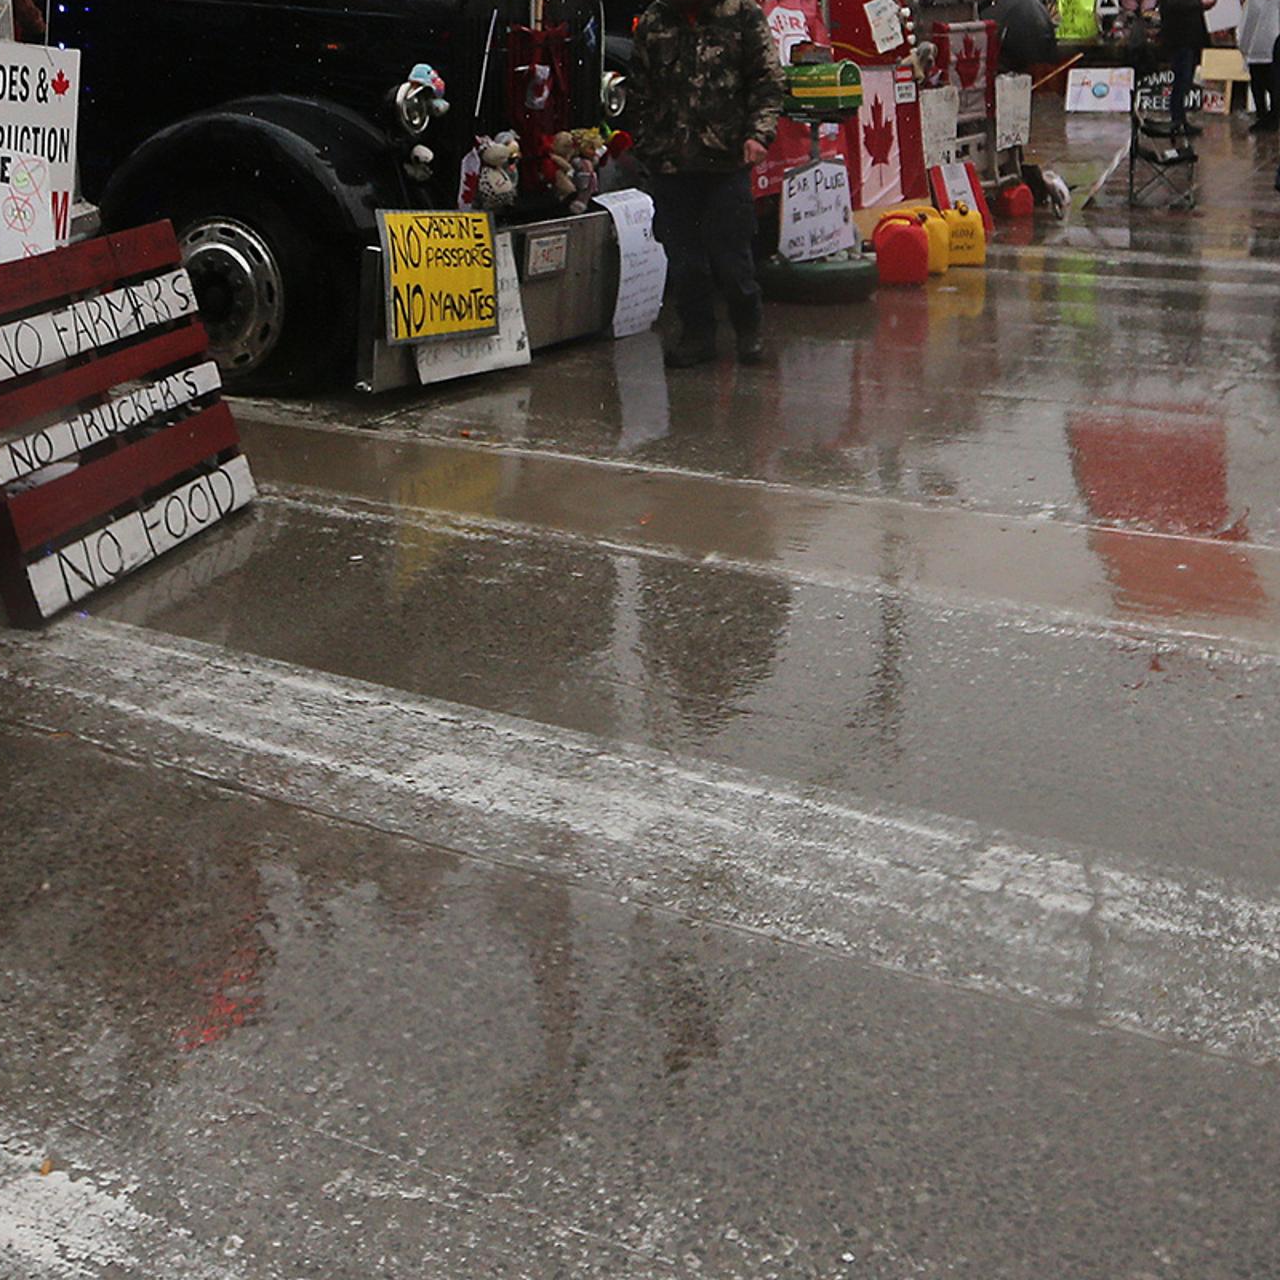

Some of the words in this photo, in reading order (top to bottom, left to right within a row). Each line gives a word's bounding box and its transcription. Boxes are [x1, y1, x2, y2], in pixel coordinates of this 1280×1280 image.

[37, 67, 49, 104] &
[388, 224, 421, 274] NO
[414, 216, 484, 240] VACCINE
[425, 244, 493, 270] PASSPORTS
[392, 284, 426, 338] NO
[429, 288, 497, 322] MANDATES
[5, 430, 55, 477] NO
[67, 371, 199, 454] TRUCKER'S
[56, 527, 125, 604] NO
[138, 467, 236, 558] FOOD
